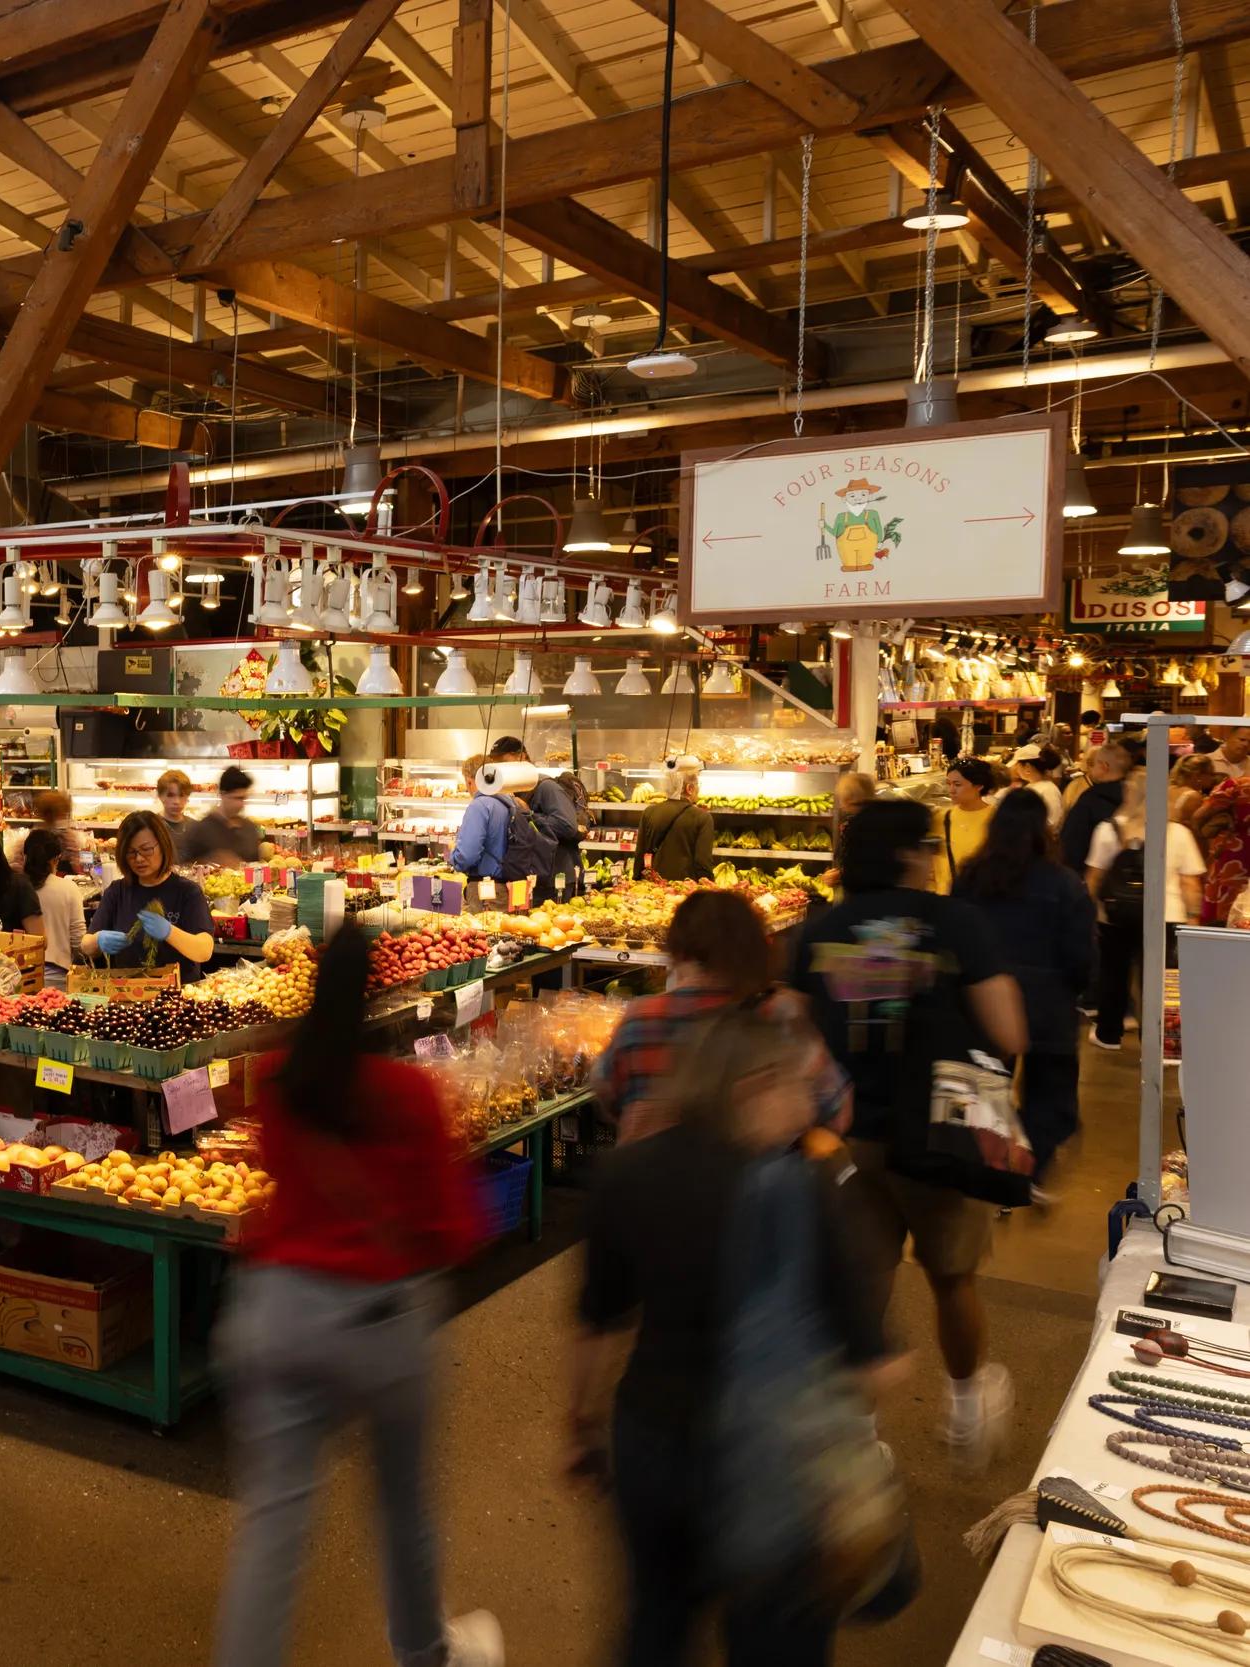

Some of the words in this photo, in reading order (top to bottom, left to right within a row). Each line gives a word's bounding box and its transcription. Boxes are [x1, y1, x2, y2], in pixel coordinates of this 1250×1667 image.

[773, 464, 834, 508] FOUR
[844, 455, 951, 494] SEASONS
[824, 580, 892, 598] FARM
[1106, 622, 1171, 632] ITALIA
